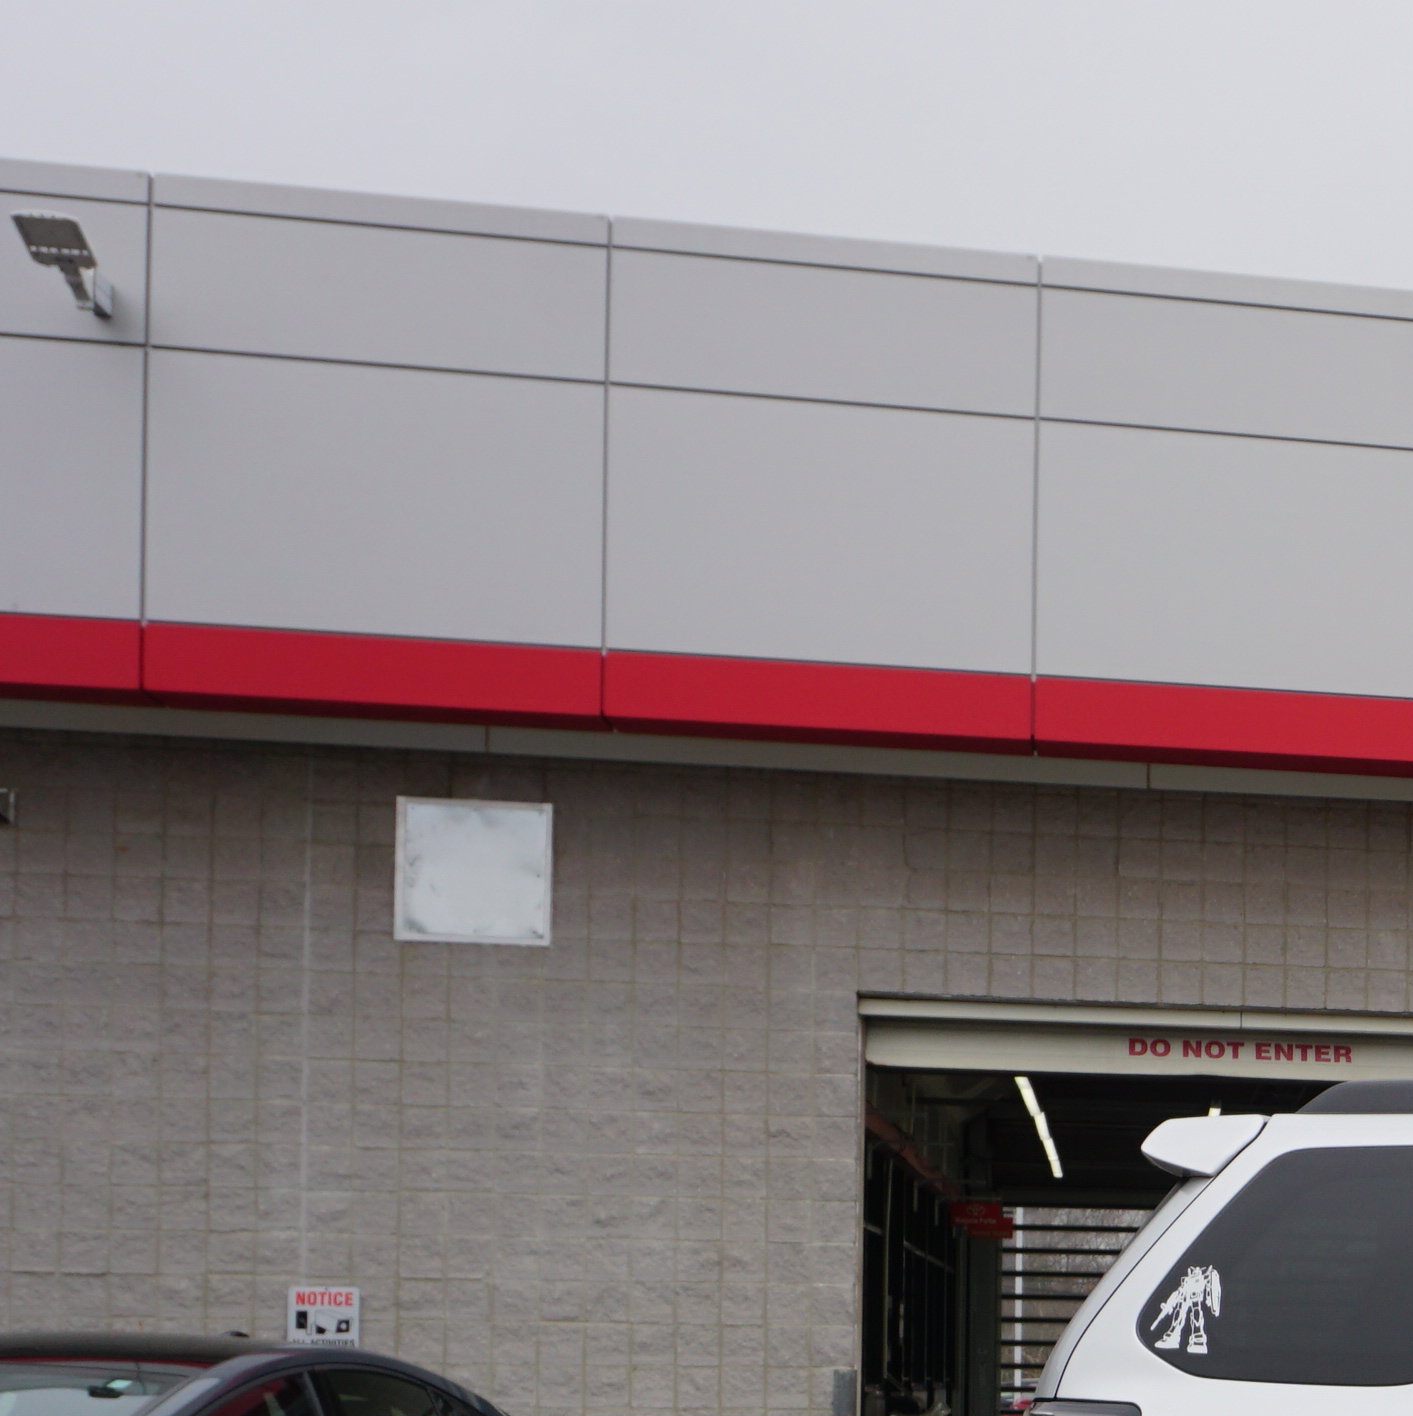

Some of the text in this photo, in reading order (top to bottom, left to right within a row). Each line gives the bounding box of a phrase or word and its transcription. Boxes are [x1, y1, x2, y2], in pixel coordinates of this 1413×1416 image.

[1128, 1037, 1352, 1063] DO NOT ENTER
[295, 1291, 353, 1307] NOTICE
